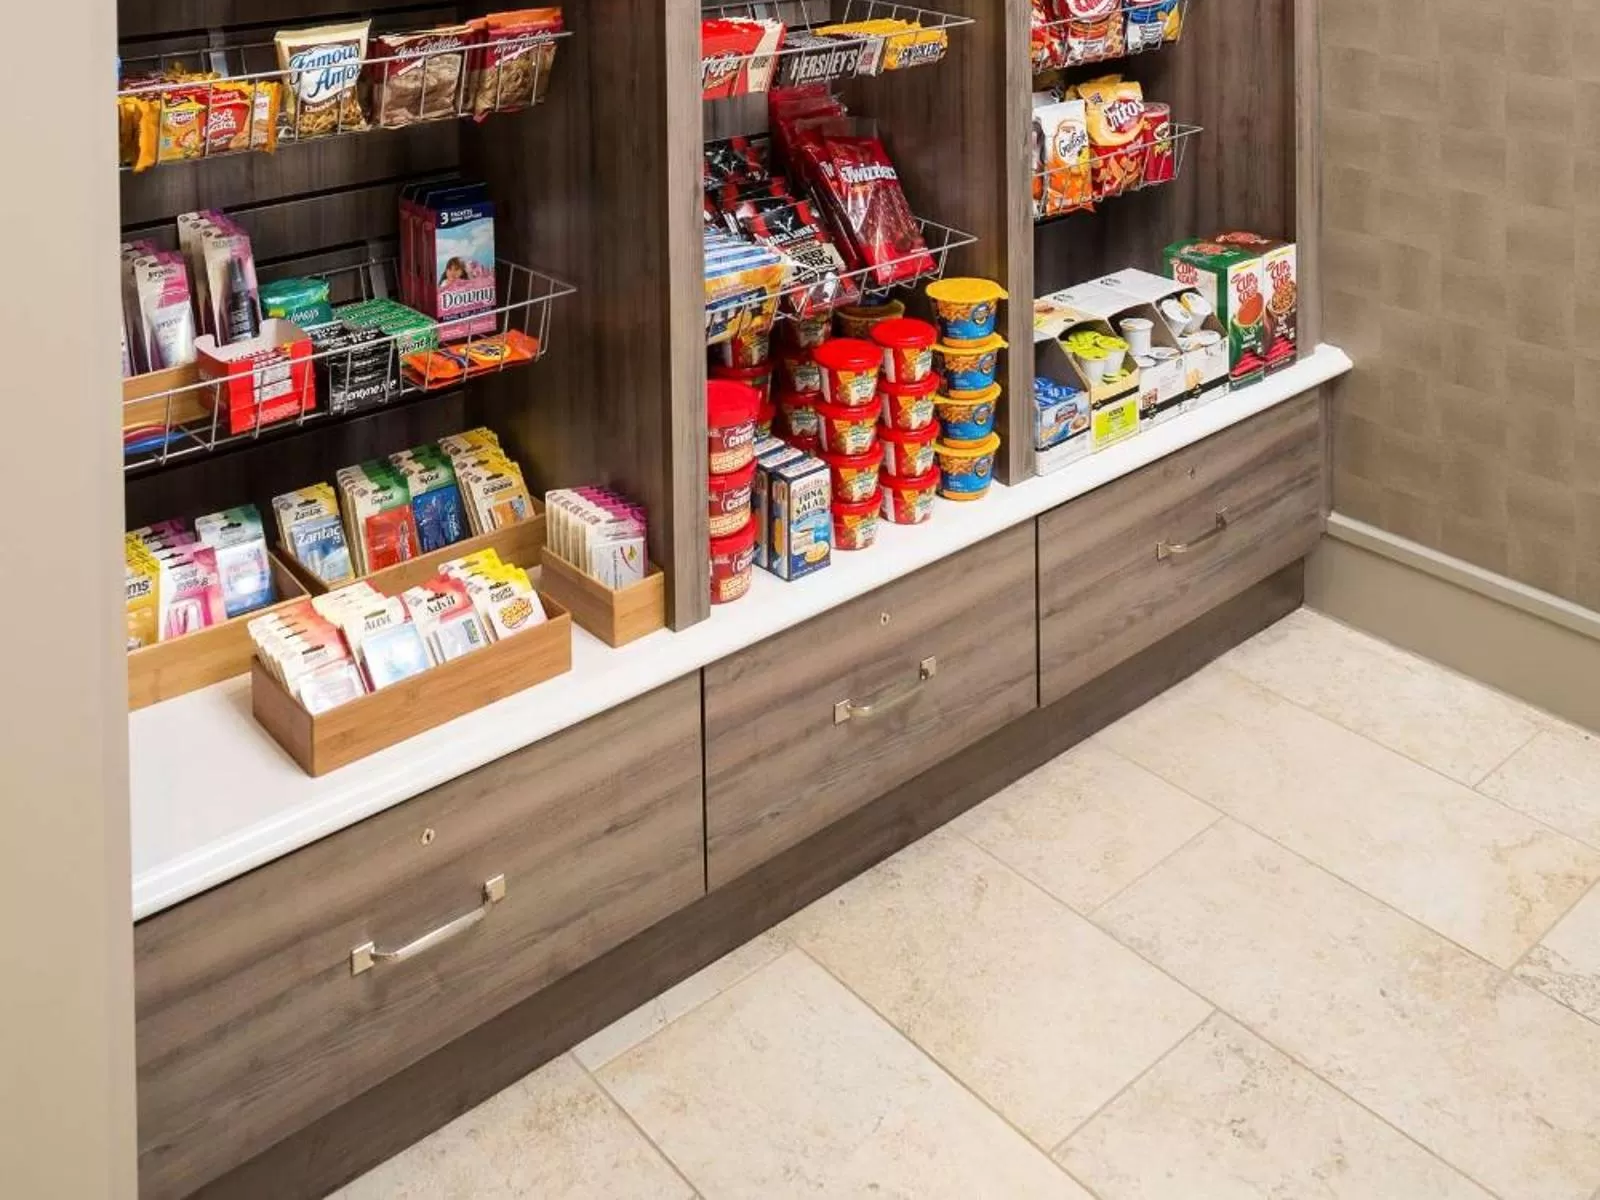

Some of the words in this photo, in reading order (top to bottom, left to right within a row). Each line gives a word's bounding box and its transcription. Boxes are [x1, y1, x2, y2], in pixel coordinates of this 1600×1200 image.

[289, 44, 360, 85] Famous
[440, 212, 449, 225] 3
[441, 287, 495, 311] Downy
